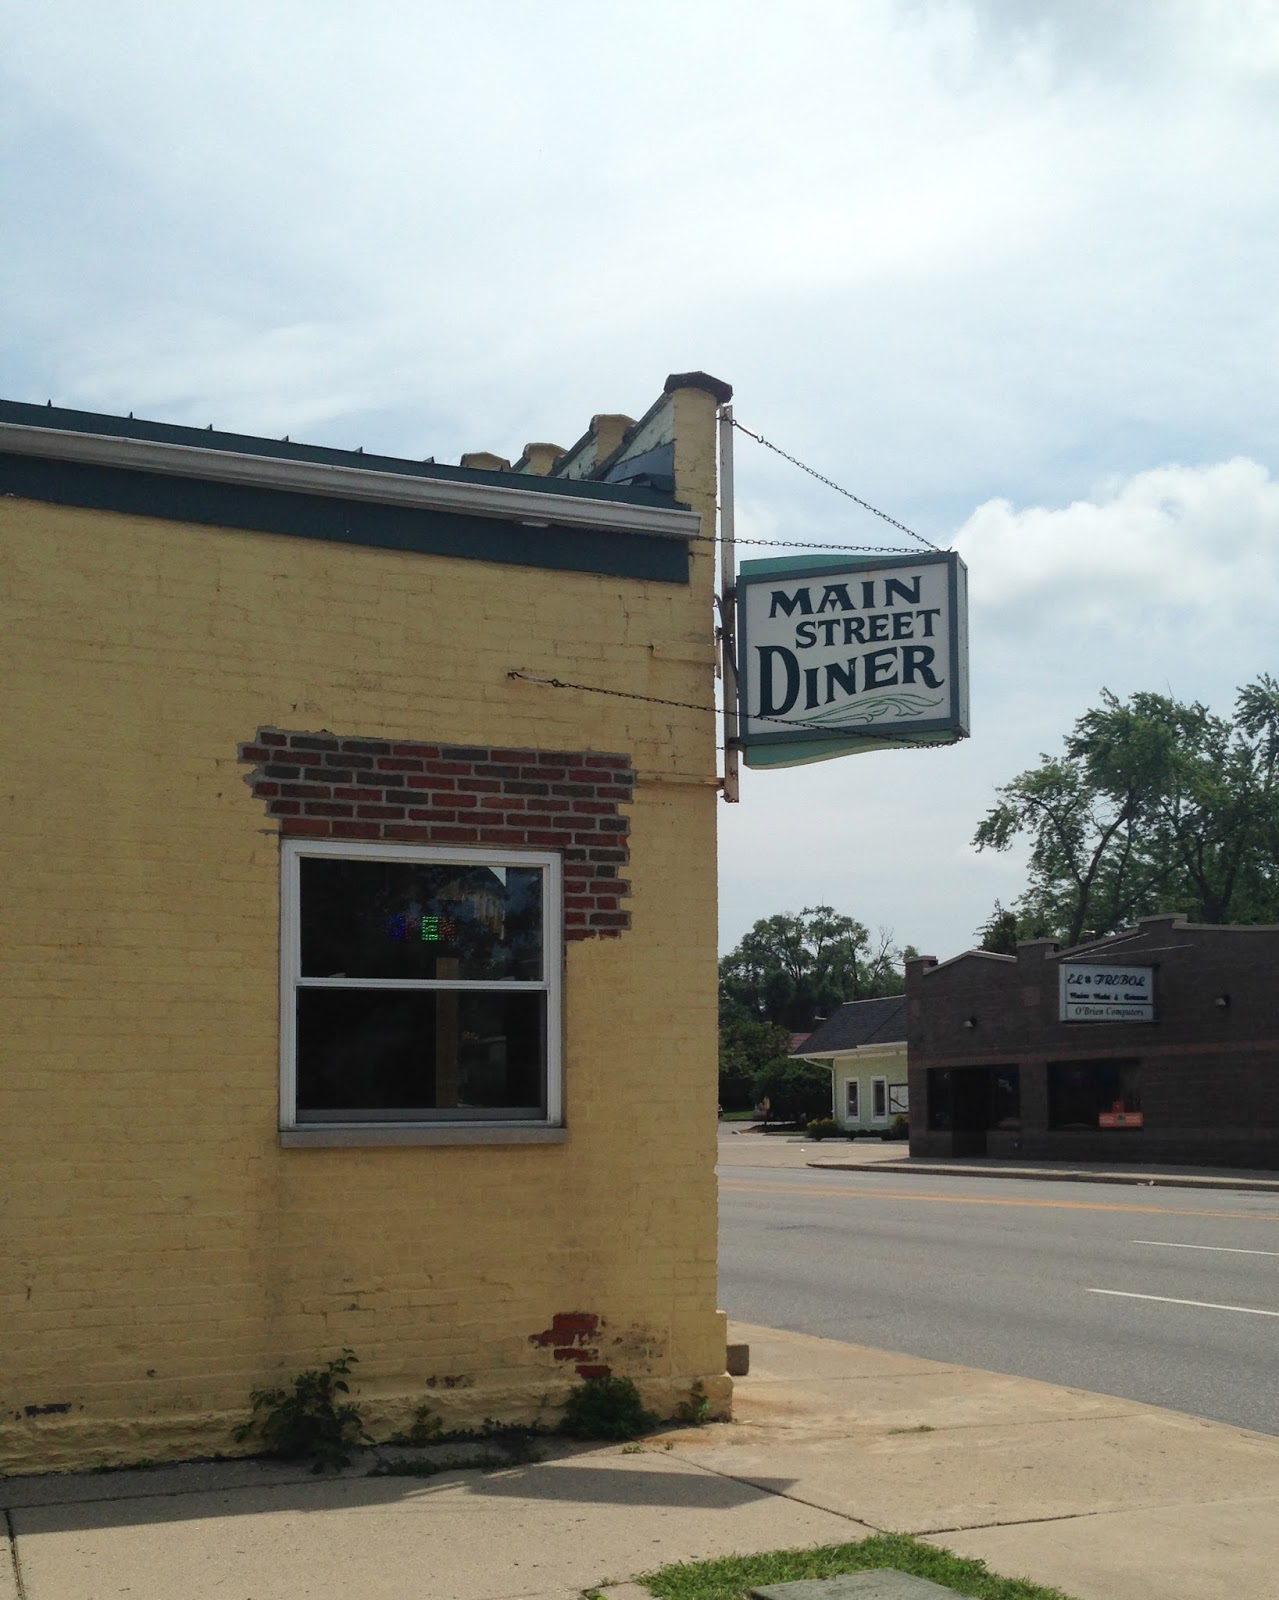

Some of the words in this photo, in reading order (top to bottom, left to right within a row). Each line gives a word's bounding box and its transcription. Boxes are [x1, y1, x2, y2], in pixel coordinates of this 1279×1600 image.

[769, 576, 922, 618] MAIN
[795, 608, 941, 649] STREET
[755, 645, 945, 718] DINER
[1075, 1007, 1104, 1016] O'Brien
[1106, 1007, 1144, 1017] Computers
